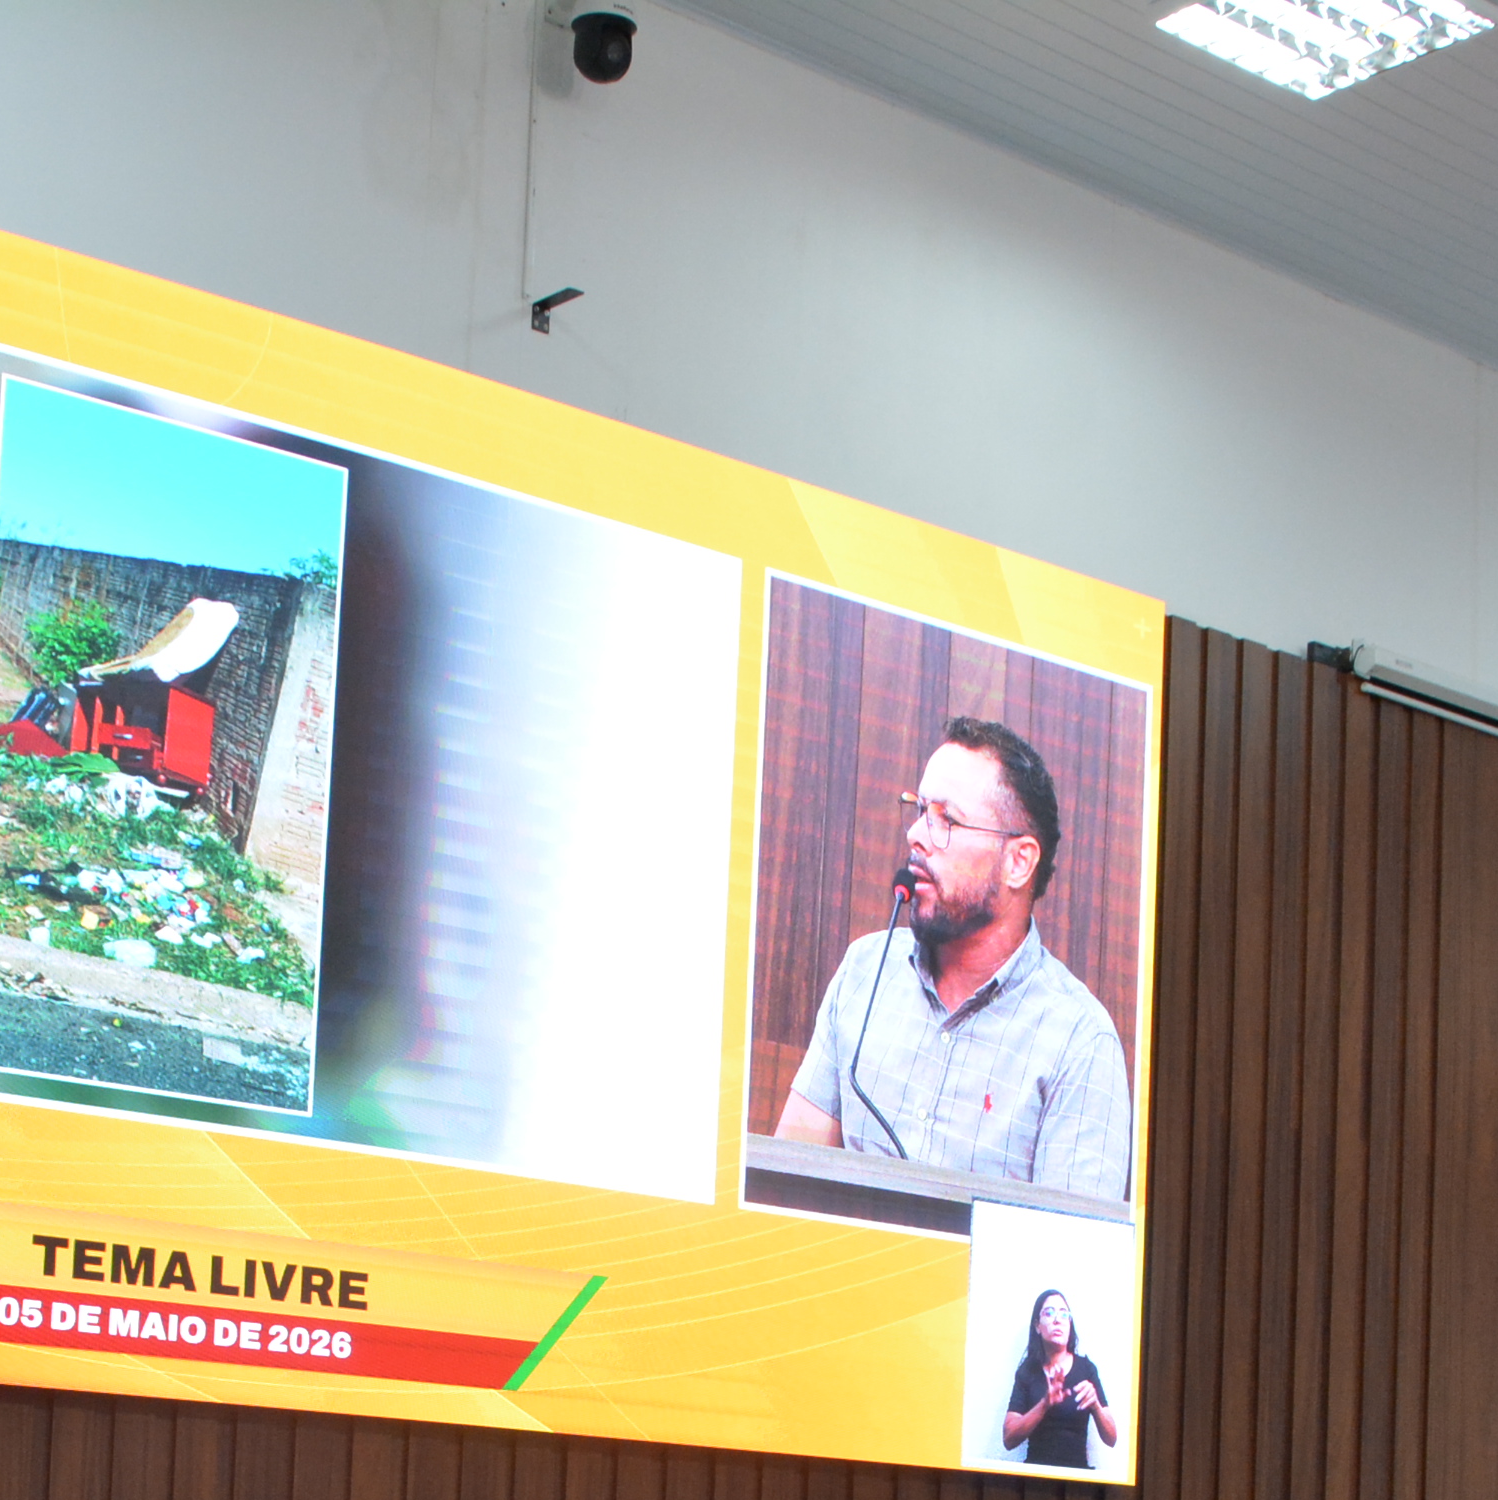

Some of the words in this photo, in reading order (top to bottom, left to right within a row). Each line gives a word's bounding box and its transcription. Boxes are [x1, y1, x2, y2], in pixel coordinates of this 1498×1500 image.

[32, 1234, 197, 1292] TEMA
[210, 1255, 369, 1311] LIVRE
[50, 1301, 101, 1334] DE
[108, 1308, 207, 1345] MAIO
[213, 1318, 262, 1351] DE
[267, 1324, 353, 1360] 2026
